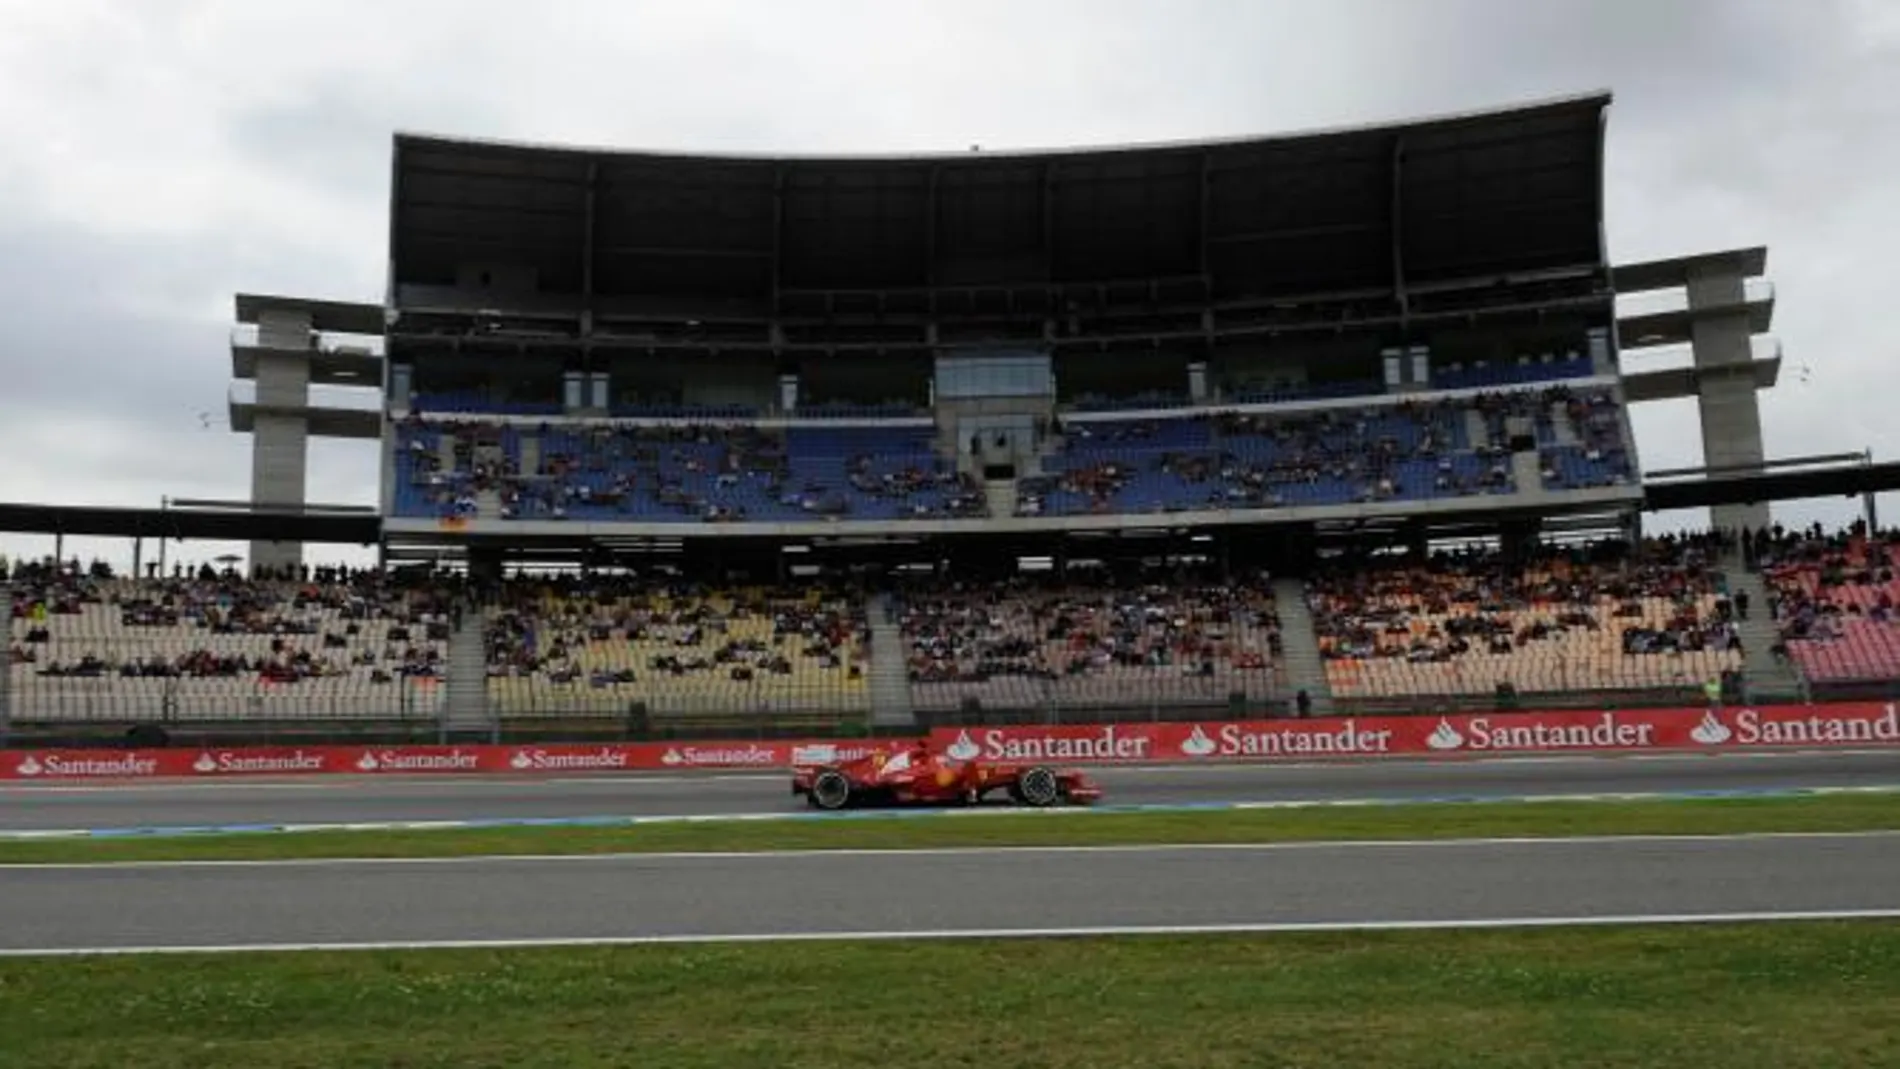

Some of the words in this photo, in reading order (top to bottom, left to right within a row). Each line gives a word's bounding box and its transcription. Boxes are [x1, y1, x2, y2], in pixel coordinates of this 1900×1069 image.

[1221, 719, 1391, 754] Santander
[1469, 712, 1653, 748] Santander
[985, 726, 1148, 758] Santander
[44, 754, 155, 775] Santander
[218, 752, 323, 771] Santander
[381, 749, 477, 769] Santander
[532, 747, 627, 768] Santander
[684, 745, 774, 767] Santander
